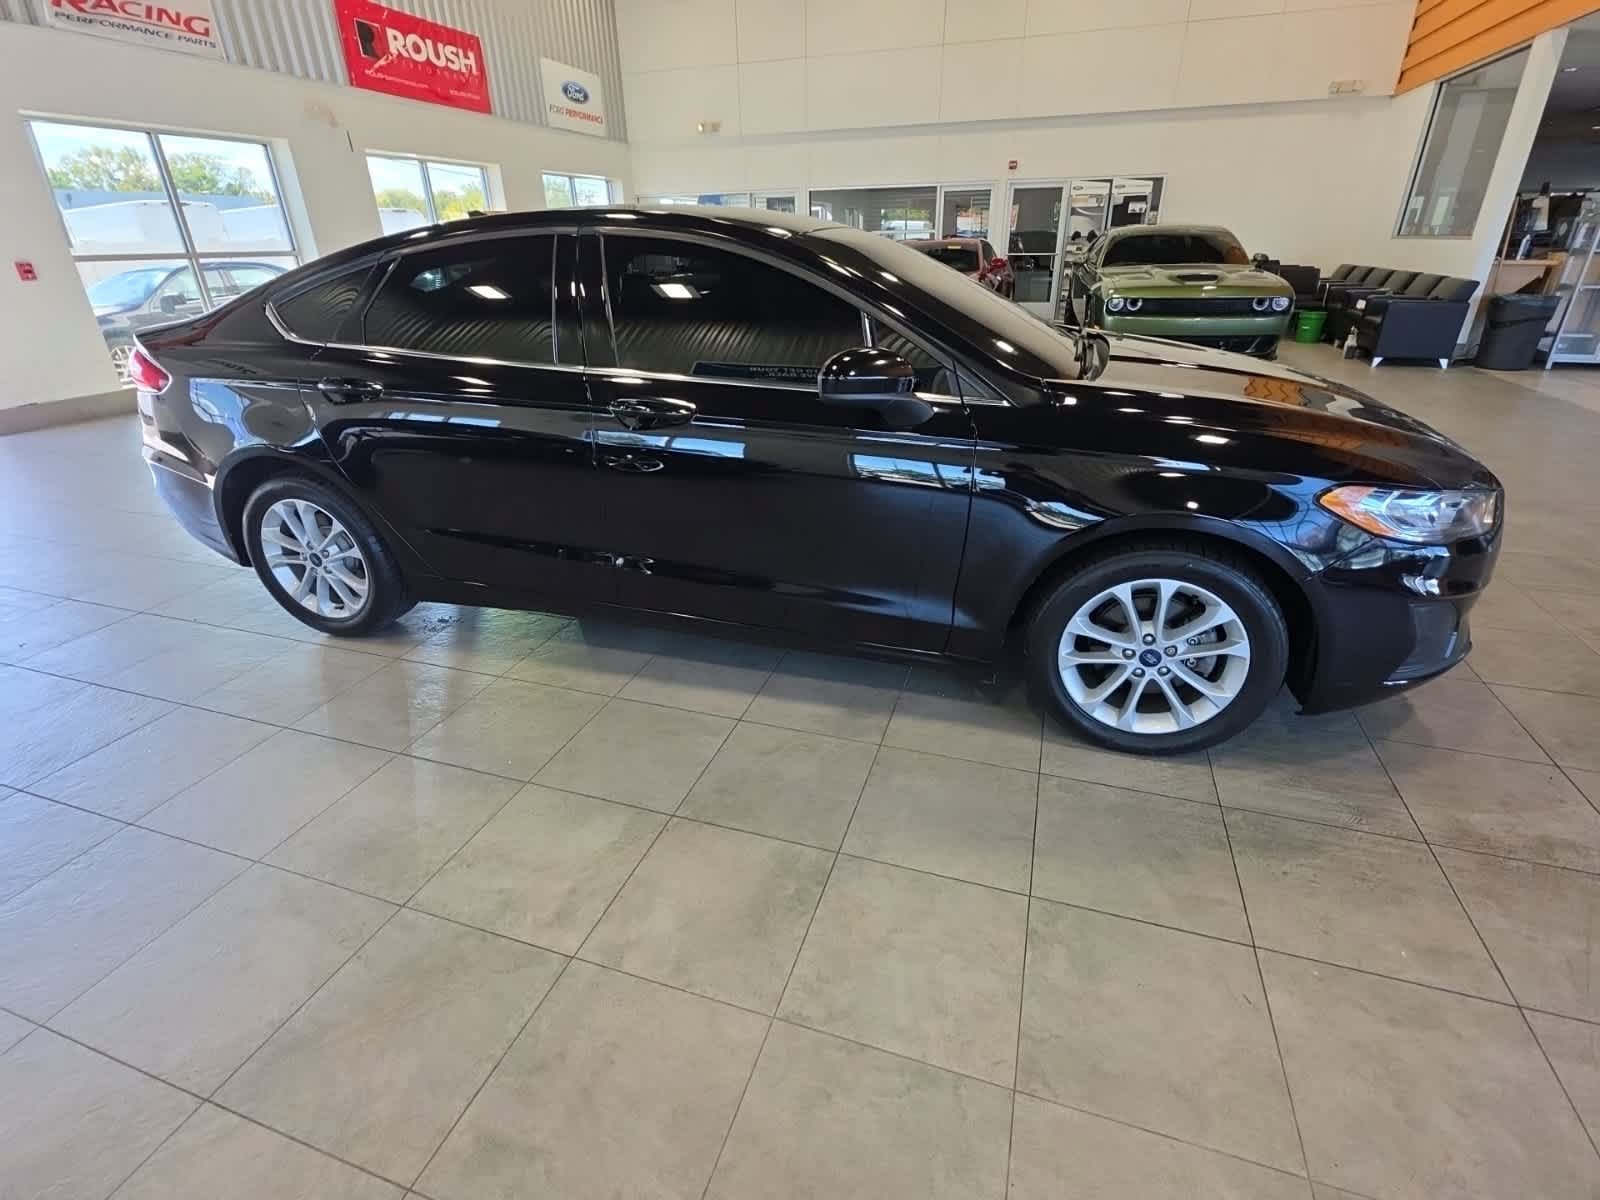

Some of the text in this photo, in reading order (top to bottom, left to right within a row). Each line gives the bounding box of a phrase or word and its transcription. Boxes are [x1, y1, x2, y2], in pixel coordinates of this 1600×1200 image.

[54, 11, 217, 49] PERFORMANCE PARTS
[385, 26, 478, 75] ROUSH
